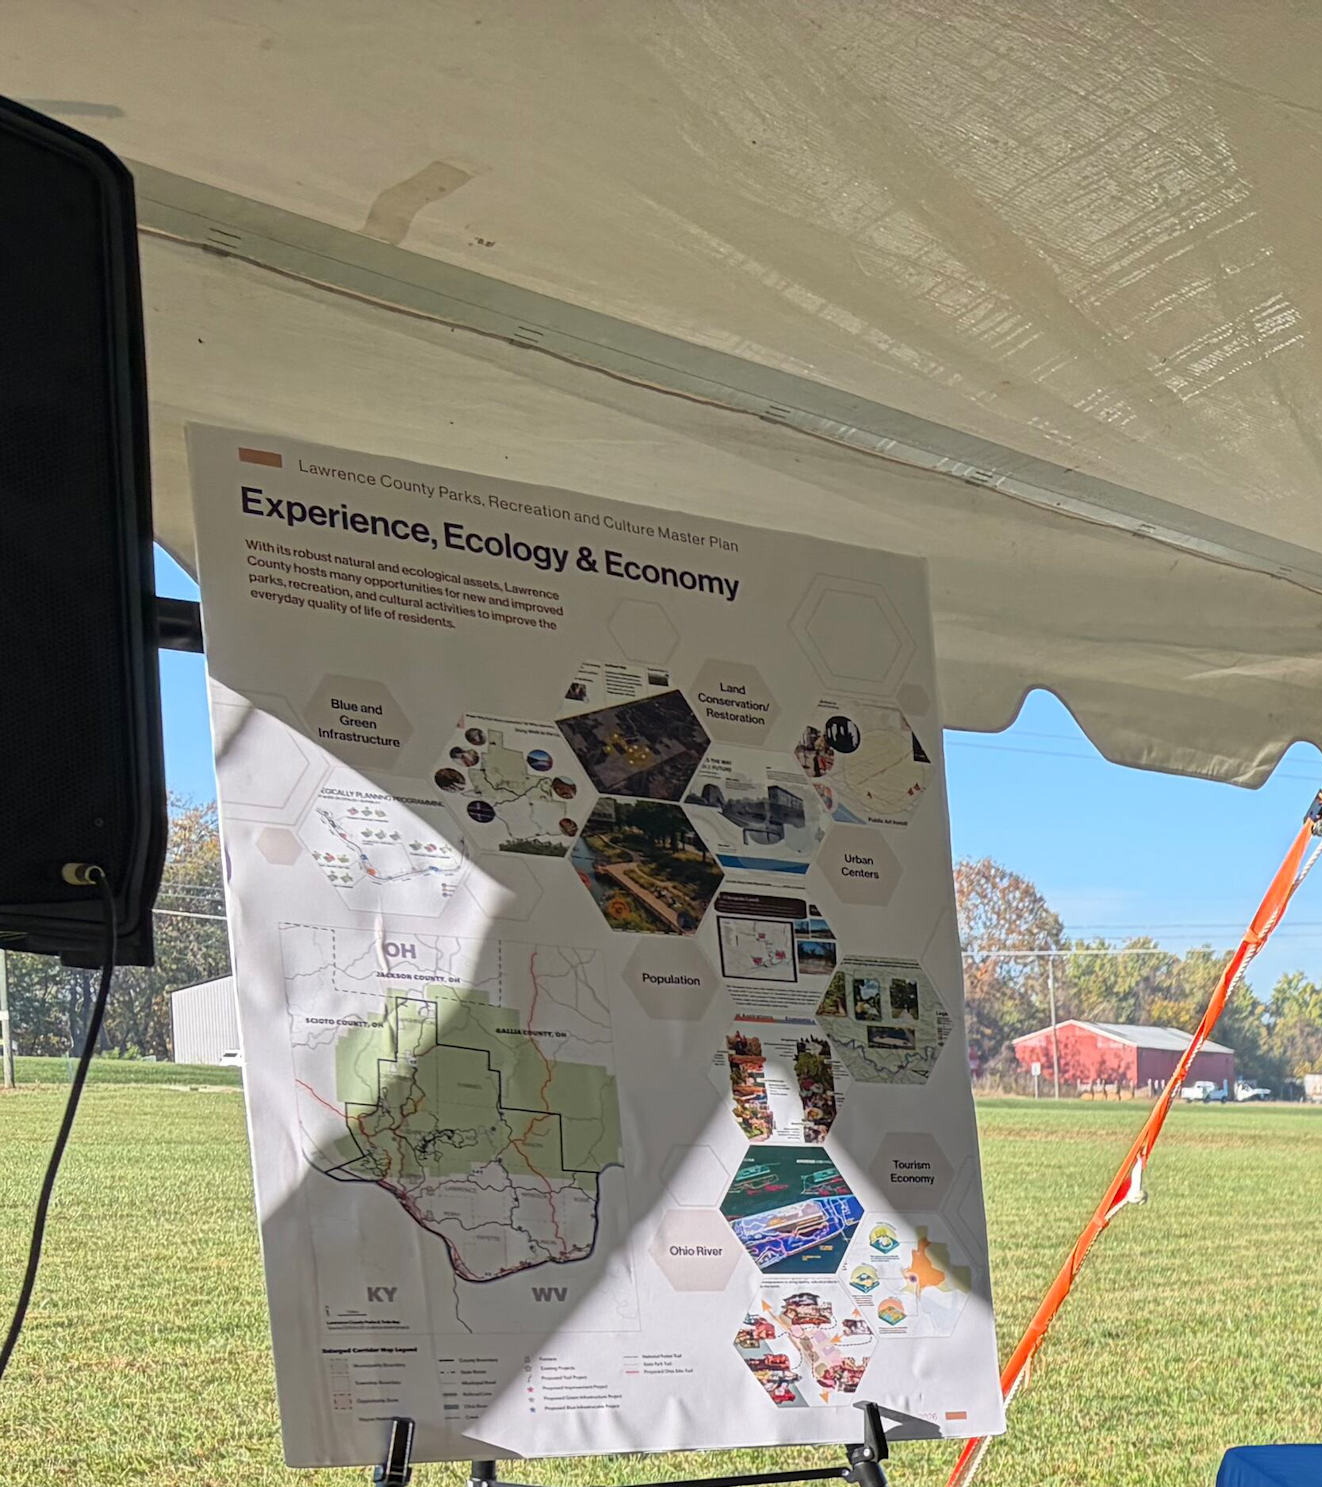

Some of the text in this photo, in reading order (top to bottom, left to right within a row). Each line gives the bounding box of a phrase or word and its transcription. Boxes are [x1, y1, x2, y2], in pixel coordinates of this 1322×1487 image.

[299, 459, 739, 552] Lawrence County Parks, Recreation and Culture Master Plan
[241, 486, 740, 601] Experience, Ecology & Economy
[246, 539, 559, 600] With its robust natural and ecological assets, Lawrence
[247, 556, 563, 616] County hosts many opportunities for new and improved
[249, 572, 557, 630] parks, recreation, and cultural activities to improve the
[251, 589, 455, 629] everyday quality of life of residents.
[720, 682, 745, 695] Land
[331, 699, 383, 715] Blue and
[698, 692, 770, 712] Conservation/
[340, 715, 376, 729] Green
[706, 708, 765, 725] Restoration
[319, 728, 400, 747] Infrastructure
[844, 853, 873, 865] Urban
[841, 866, 879, 879] Centers
[386, 942, 416, 959] OH
[642, 973, 700, 987] Population
[892, 1160, 930, 1171] Tourism
[890, 1173, 935, 1184] Economy
[670, 1246, 722, 1257] Ohio River
[367, 1287, 398, 1302] KY
[532, 1287, 568, 1302] WV
